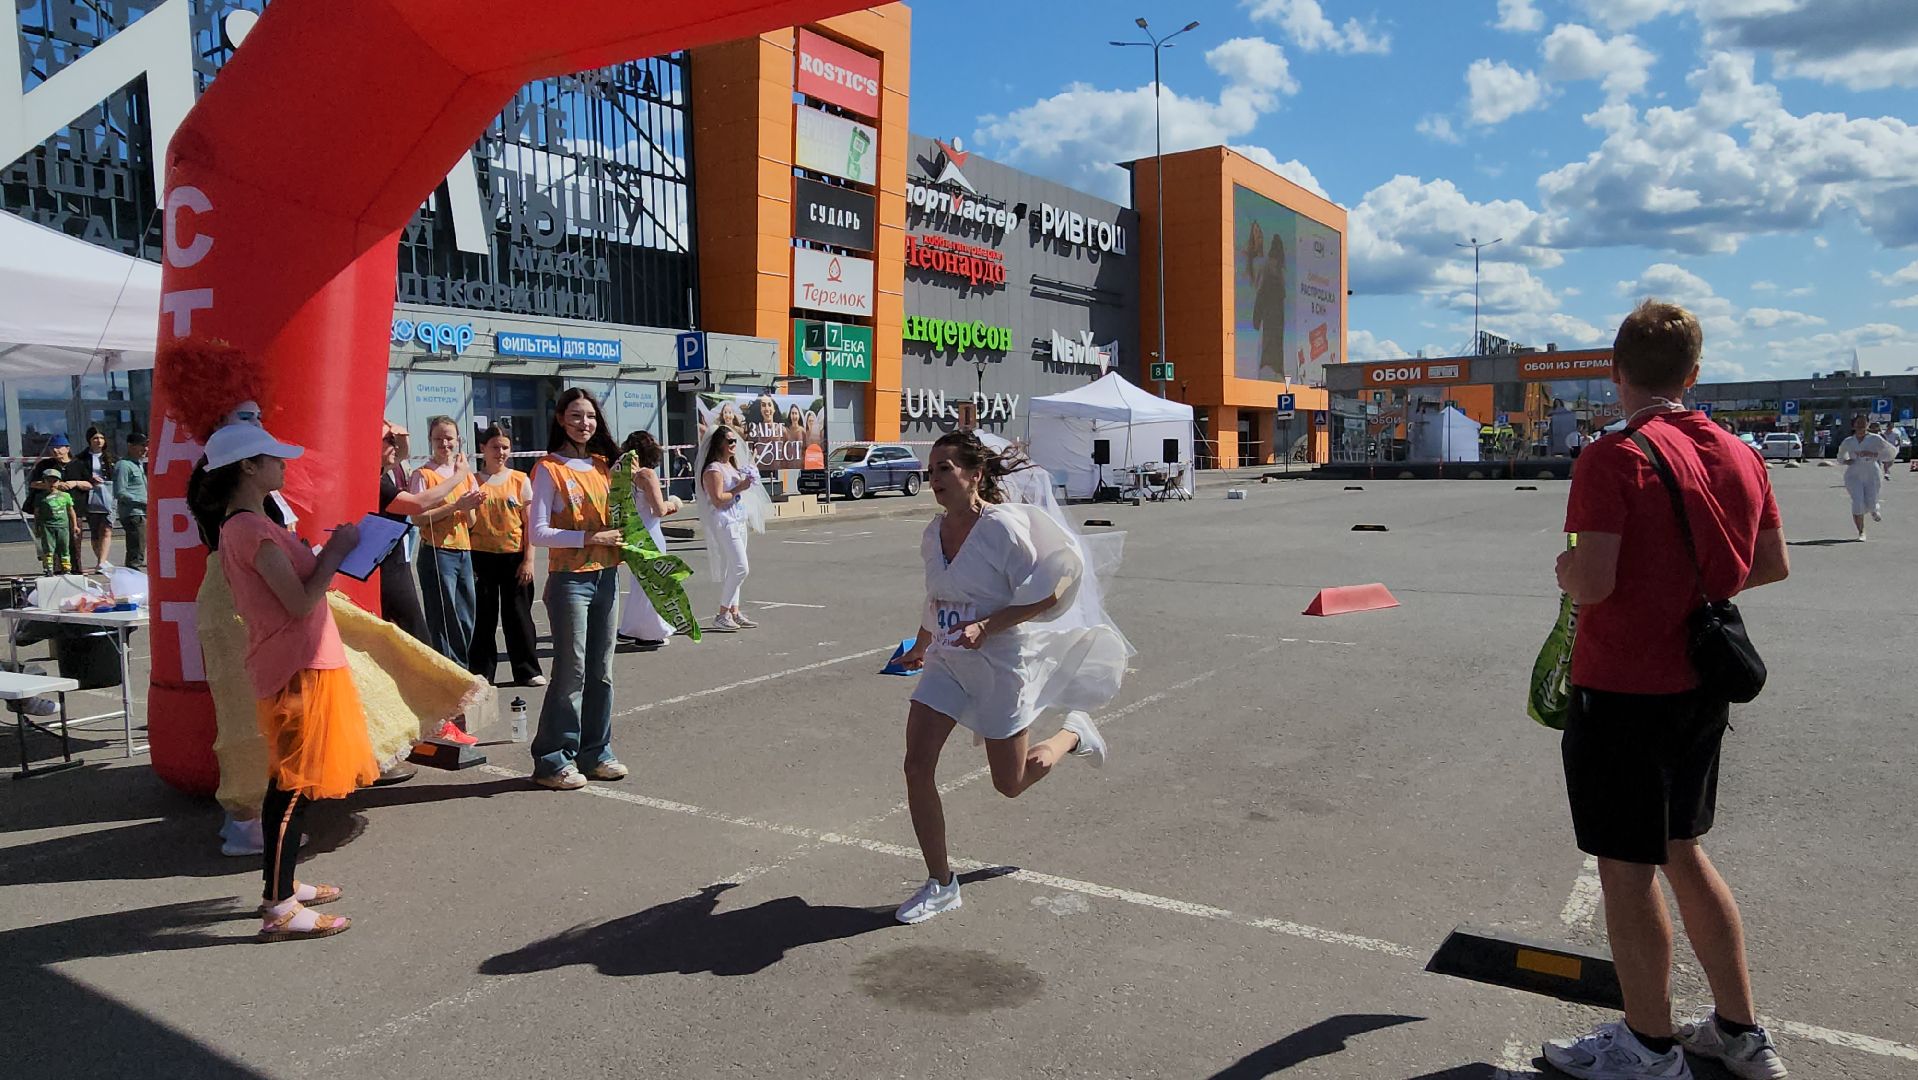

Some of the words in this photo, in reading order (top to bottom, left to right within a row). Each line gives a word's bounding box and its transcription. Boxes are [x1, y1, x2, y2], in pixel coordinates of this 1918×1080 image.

[800, 53, 878, 97] ROSTIC'S
[809, 203, 861, 230] СУДАРЬ
[1041, 203, 1085, 244] РИВ
[1087, 217, 1127, 255] ГОШ
[508, 245, 611, 283] МАСКА
[802, 283, 866, 309] Теремок
[811, 329, 819, 343] 7
[831, 329, 838, 343] 7
[501, 337, 560, 355] ФИЛЬТРЫ
[563, 340, 585, 357] ДЛЯ
[588, 342, 619, 358] ВОДЫ
[683, 337, 699, 367] P
[1155, 367, 1162, 377] 8
[1524, 362, 1554, 371] ОБОИ
[1556, 361, 1570, 370] ИЗ
[1372, 367, 1421, 382] ОБОИ
[1282, 396, 1291, 409] P
[1785, 401, 1796, 413] P
[1877, 400, 1888, 412] P
[749, 422, 786, 438] ЗАБЕГ
[937, 609, 960, 629] 40
